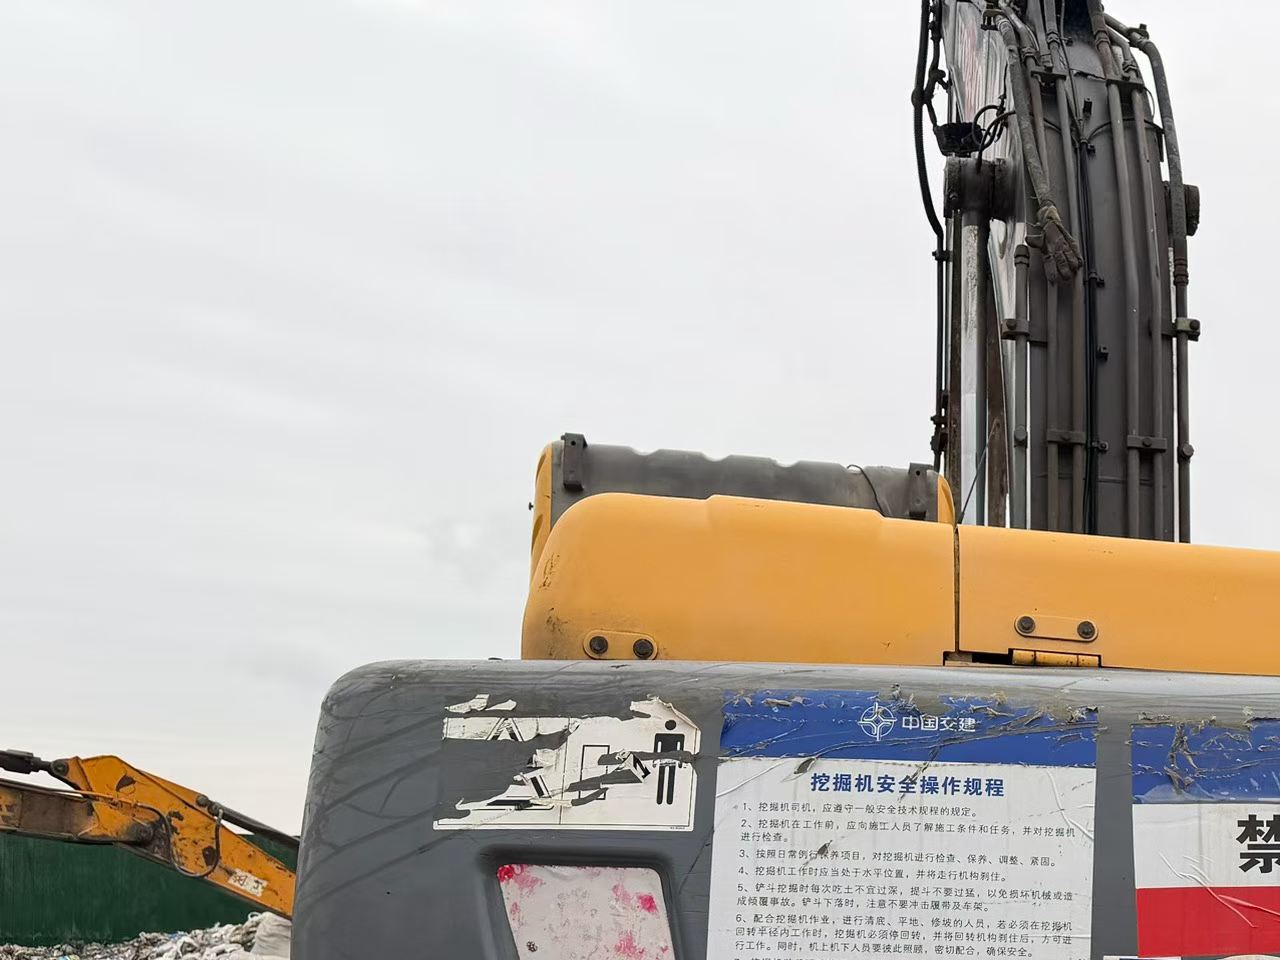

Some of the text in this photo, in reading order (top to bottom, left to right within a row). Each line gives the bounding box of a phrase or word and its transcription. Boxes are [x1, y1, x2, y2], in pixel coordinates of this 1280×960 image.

[810, 772, 1005, 797] 挖掘机安全操作规程
